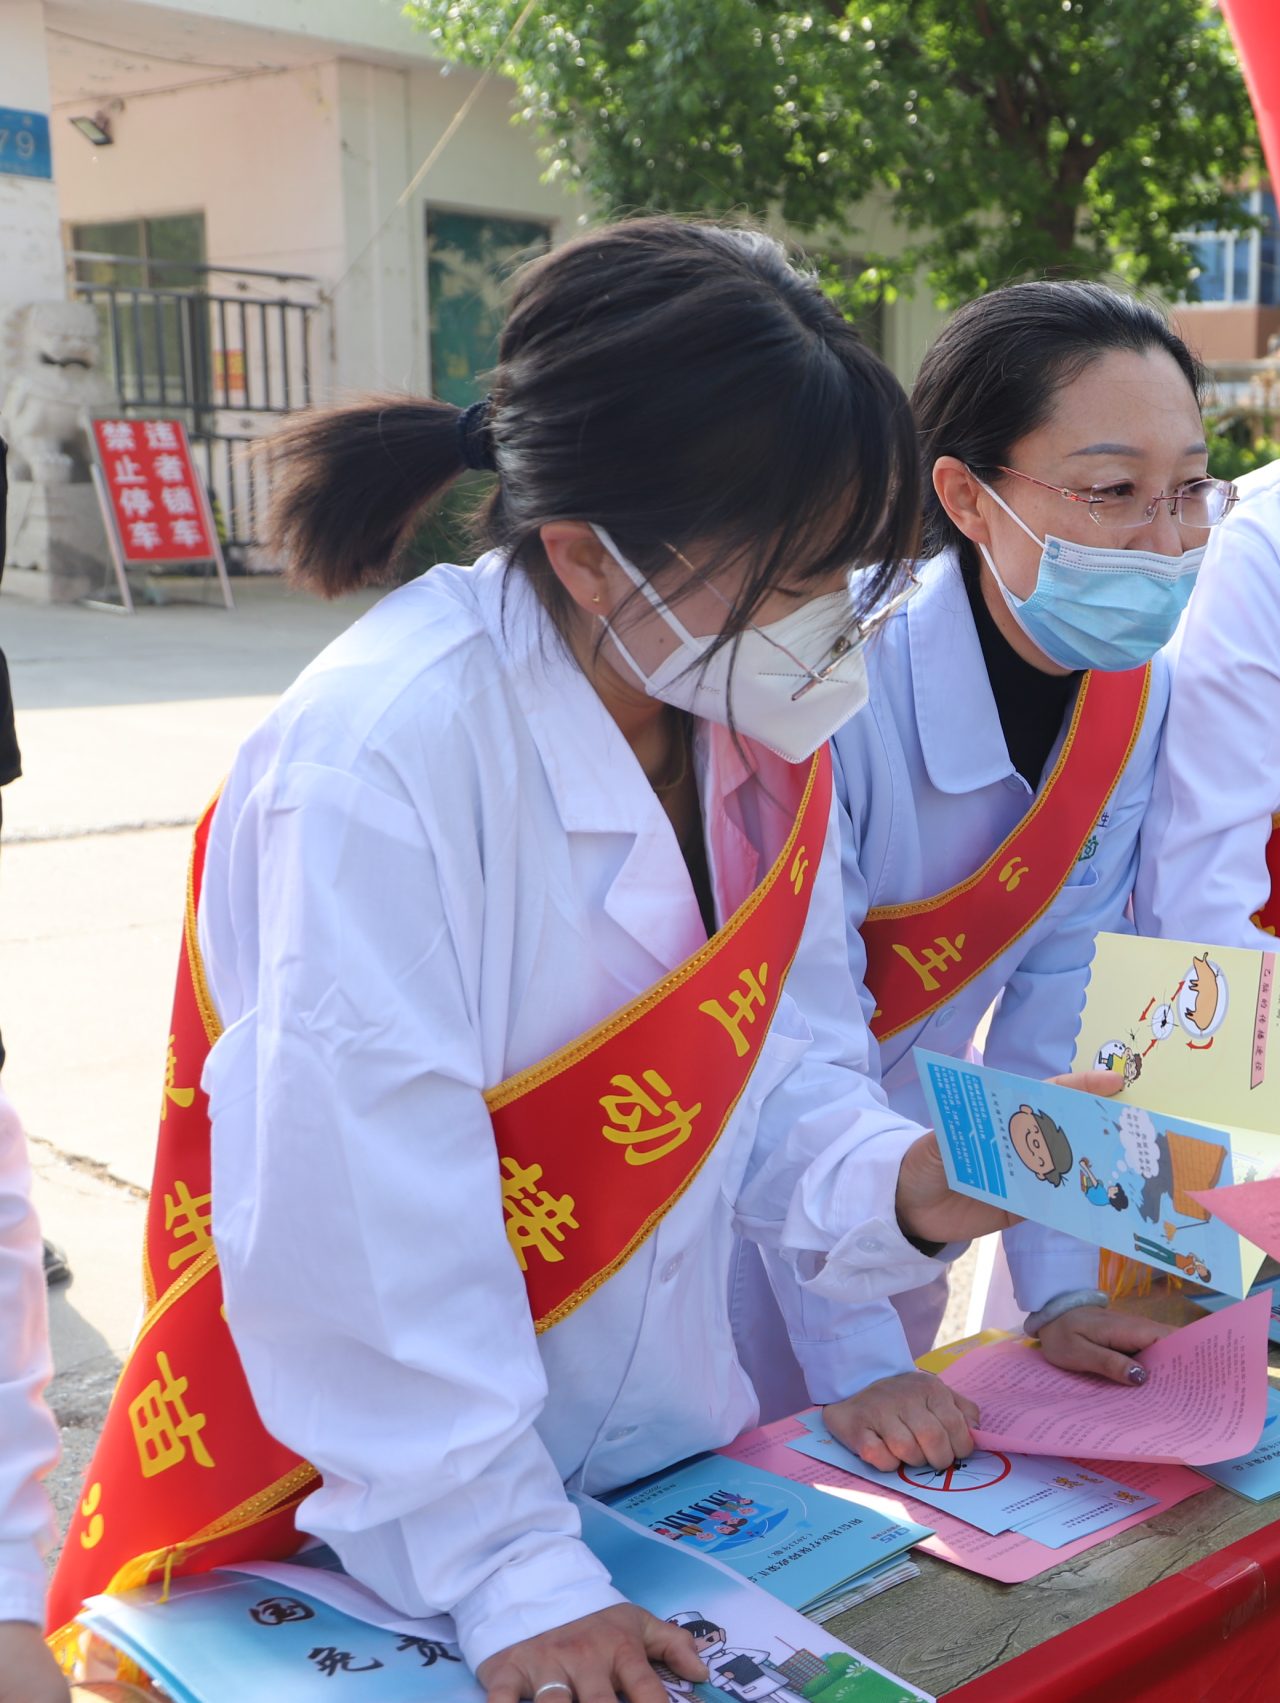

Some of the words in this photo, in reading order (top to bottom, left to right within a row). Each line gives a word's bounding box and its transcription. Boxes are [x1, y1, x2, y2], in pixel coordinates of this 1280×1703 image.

[101, 421, 163, 552] 禁止停车
[144, 420, 203, 548] 违者锁车
